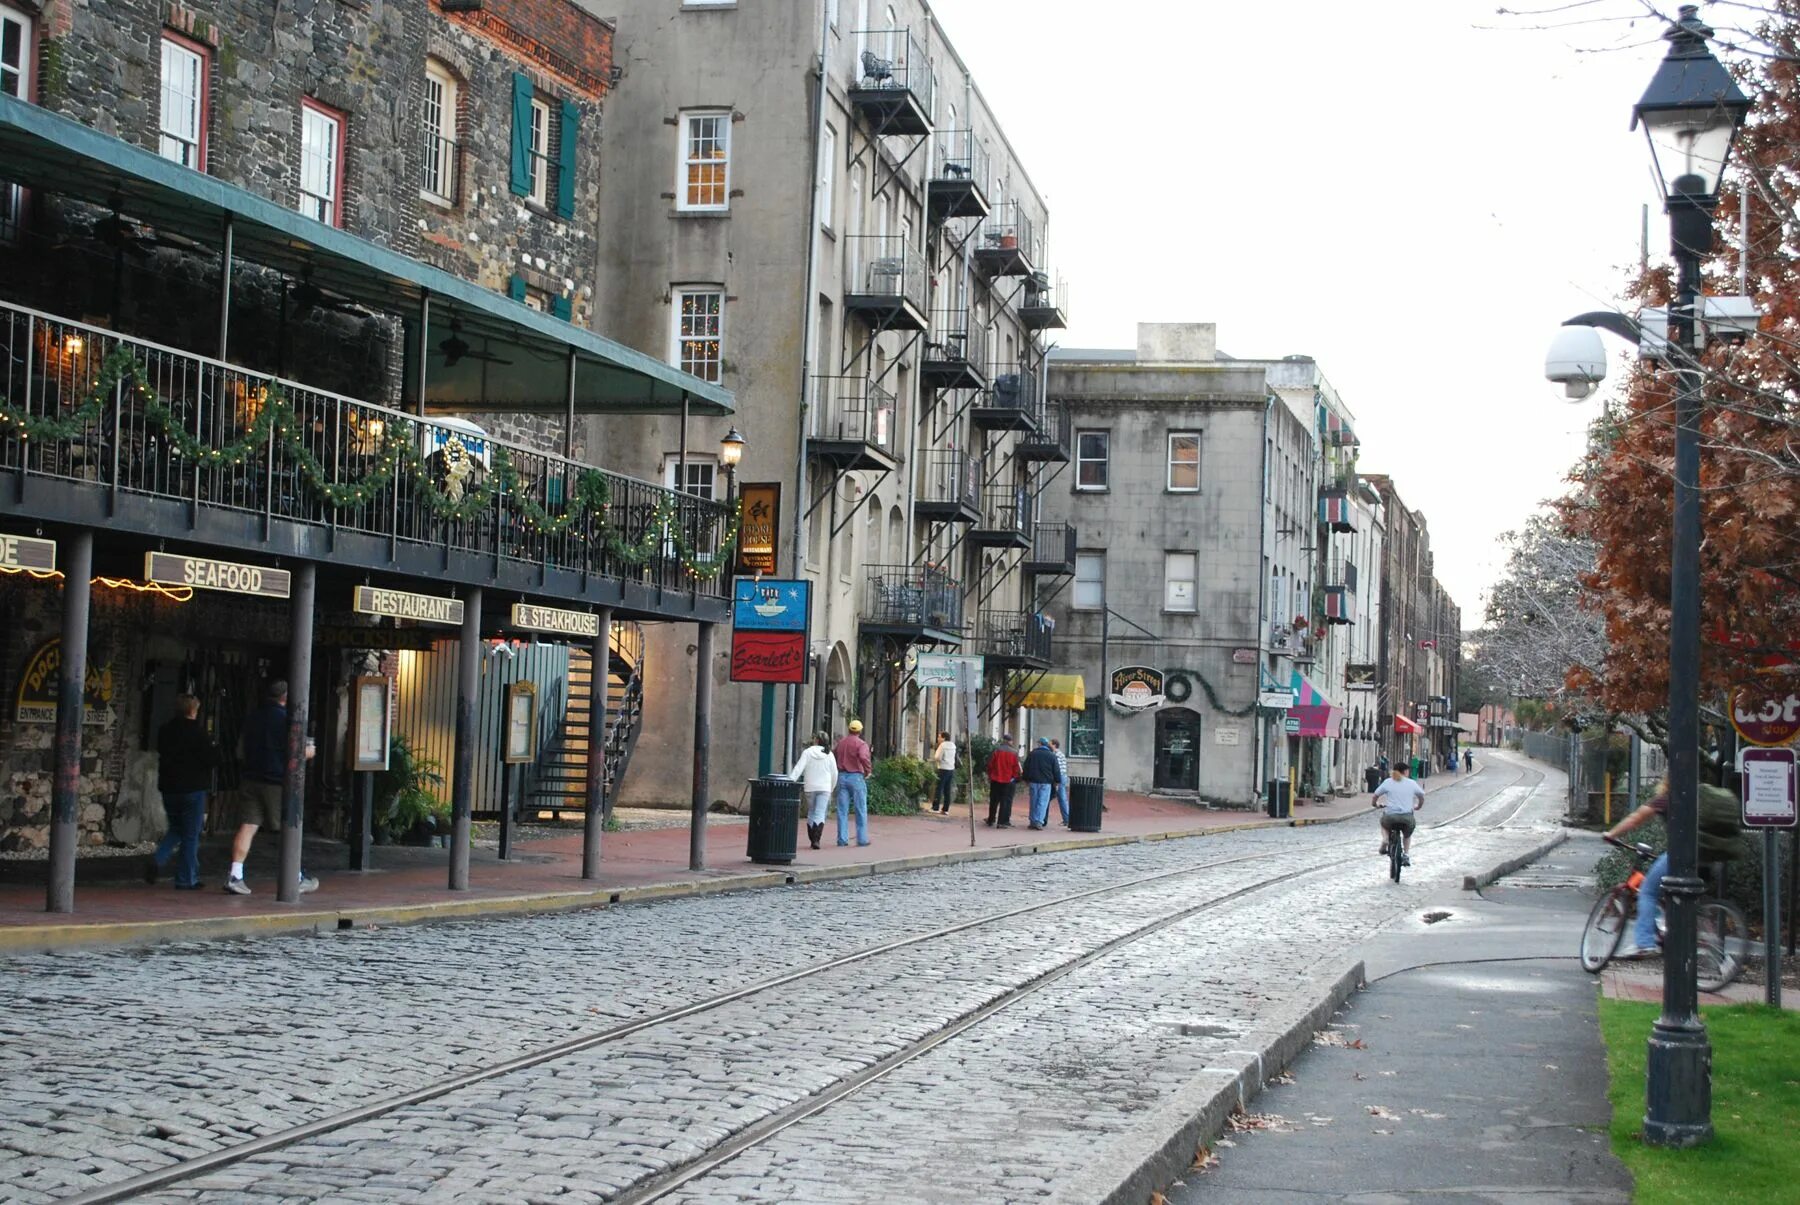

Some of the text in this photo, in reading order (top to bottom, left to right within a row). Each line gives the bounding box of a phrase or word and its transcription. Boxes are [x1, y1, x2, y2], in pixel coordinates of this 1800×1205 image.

[184, 559, 262, 592] SEAFOOD
[372, 590, 452, 620] RESTAURANT
[519, 607, 596, 634] & STEAKHOUSE
[734, 646, 801, 670] Scarlett's
[1114, 669, 1160, 691] River Street
[20, 708, 110, 723] ENTRANCE STREET
[1762, 724, 1788, 736] stop
